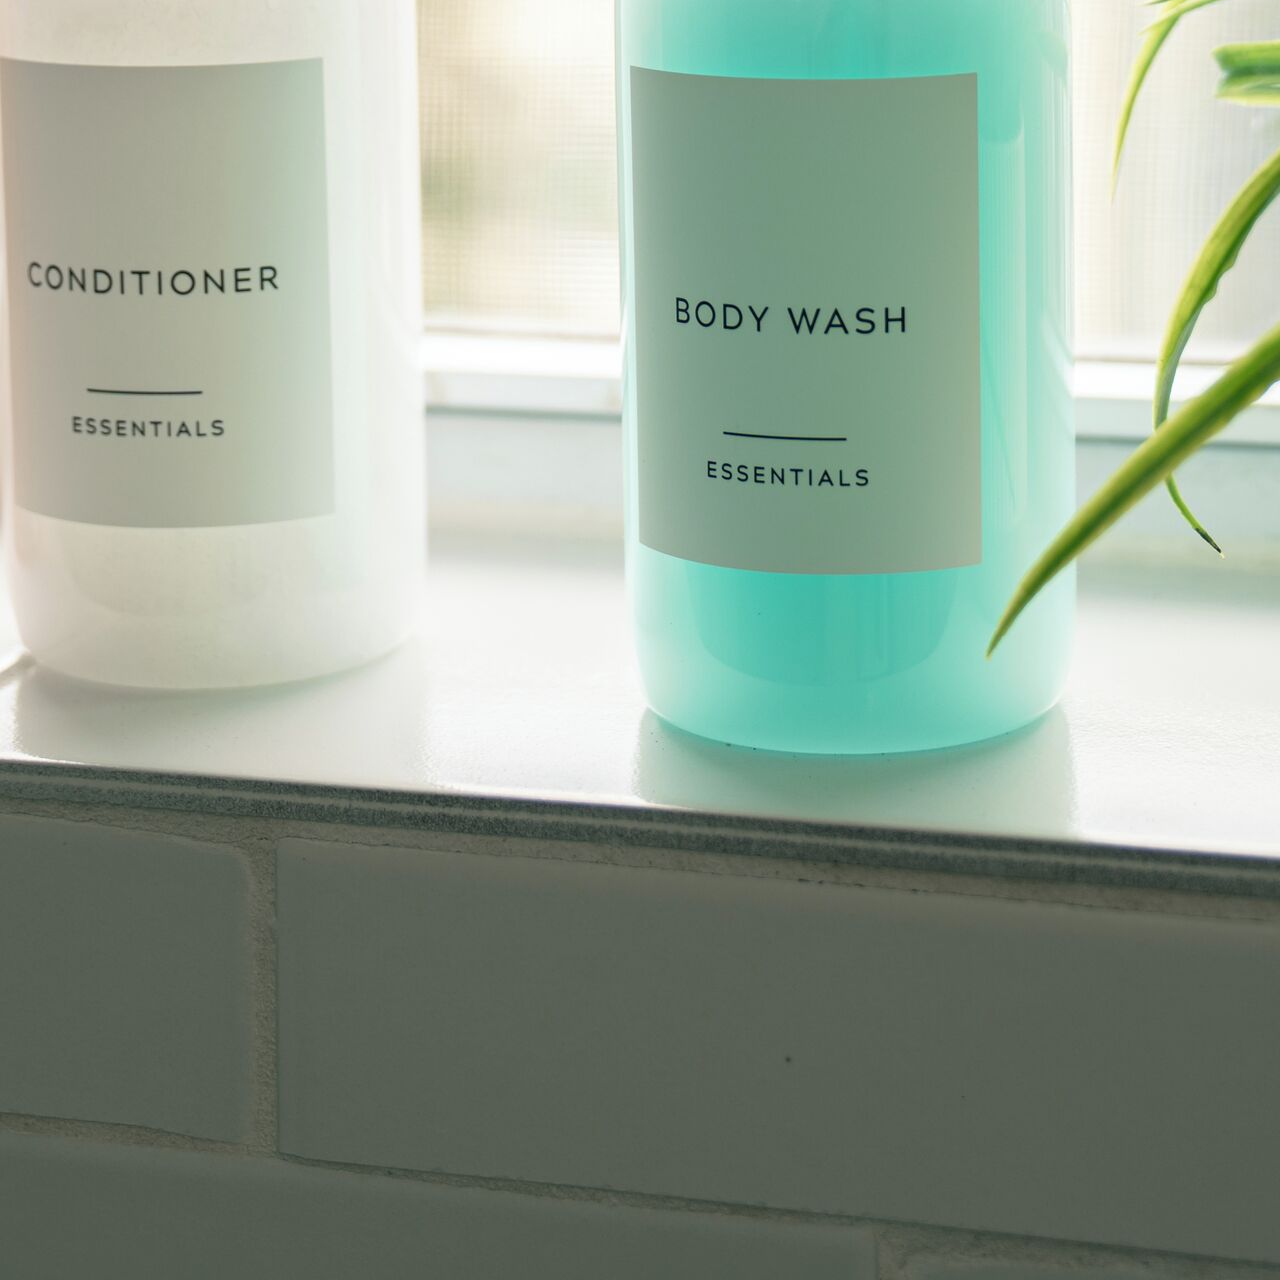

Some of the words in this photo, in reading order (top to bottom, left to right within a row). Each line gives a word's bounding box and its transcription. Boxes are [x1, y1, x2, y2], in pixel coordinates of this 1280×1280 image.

[27, 261, 279, 296] CONDITIONER
[674, 296, 770, 333] BODY
[786, 306, 907, 335] WASH
[71, 414, 226, 439] ESSENTIALS
[706, 459, 870, 488] ESSENTIALS
